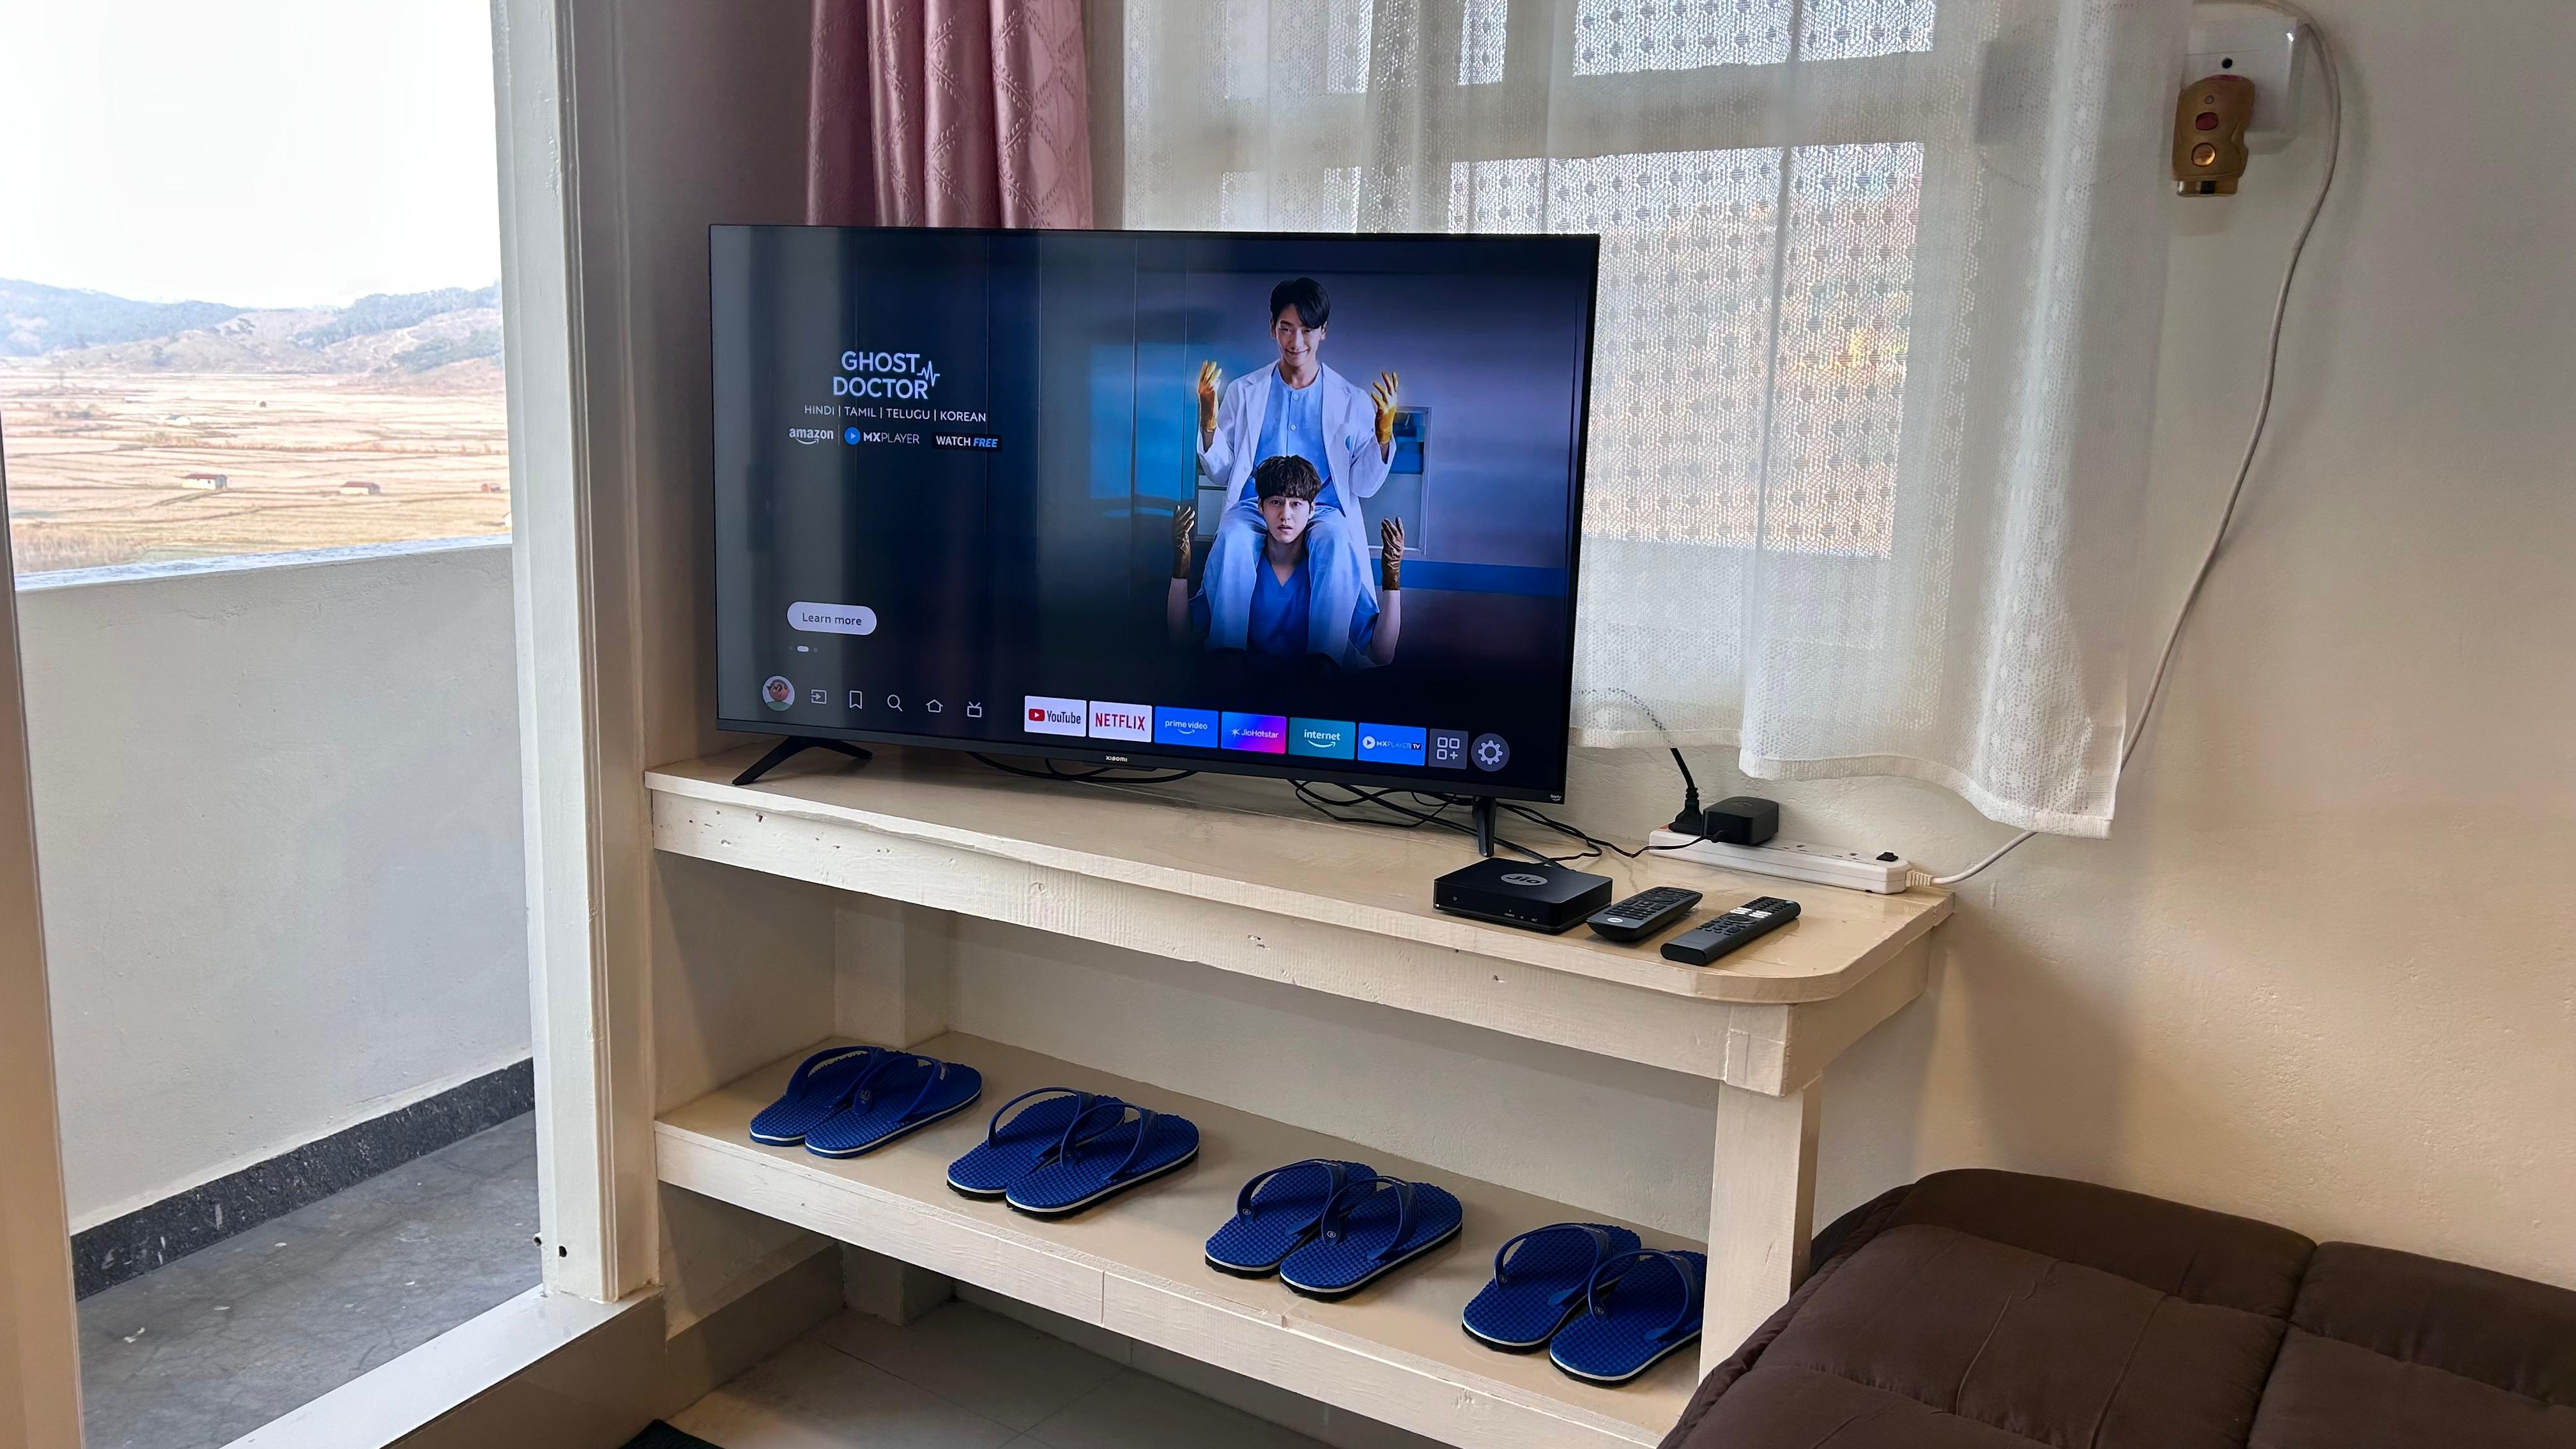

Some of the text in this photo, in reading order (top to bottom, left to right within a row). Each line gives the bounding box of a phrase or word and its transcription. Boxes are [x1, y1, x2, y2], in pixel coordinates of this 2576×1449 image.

[841, 351, 920, 373] GHOST
[832, 376, 928, 399] DOCTOR
[804, 404, 834, 415] HINDI
[844, 406, 876, 418] TAMIL
[886, 408, 930, 420] TELUGU
[940, 410, 986, 422] KOREAN
[788, 427, 834, 440] amazon
[936, 436, 999, 448] WATCH FREE
[802, 613, 862, 626] Learn more
[1046, 710, 1081, 724] YouTube
[1095, 712, 1146, 731] NETFLIX
[1165, 719, 1208, 730] prime video
[1241, 728, 1279, 739] JioHotstar
[1304, 729, 1341, 741] internet
[1506, 876, 1542, 884] Jio
